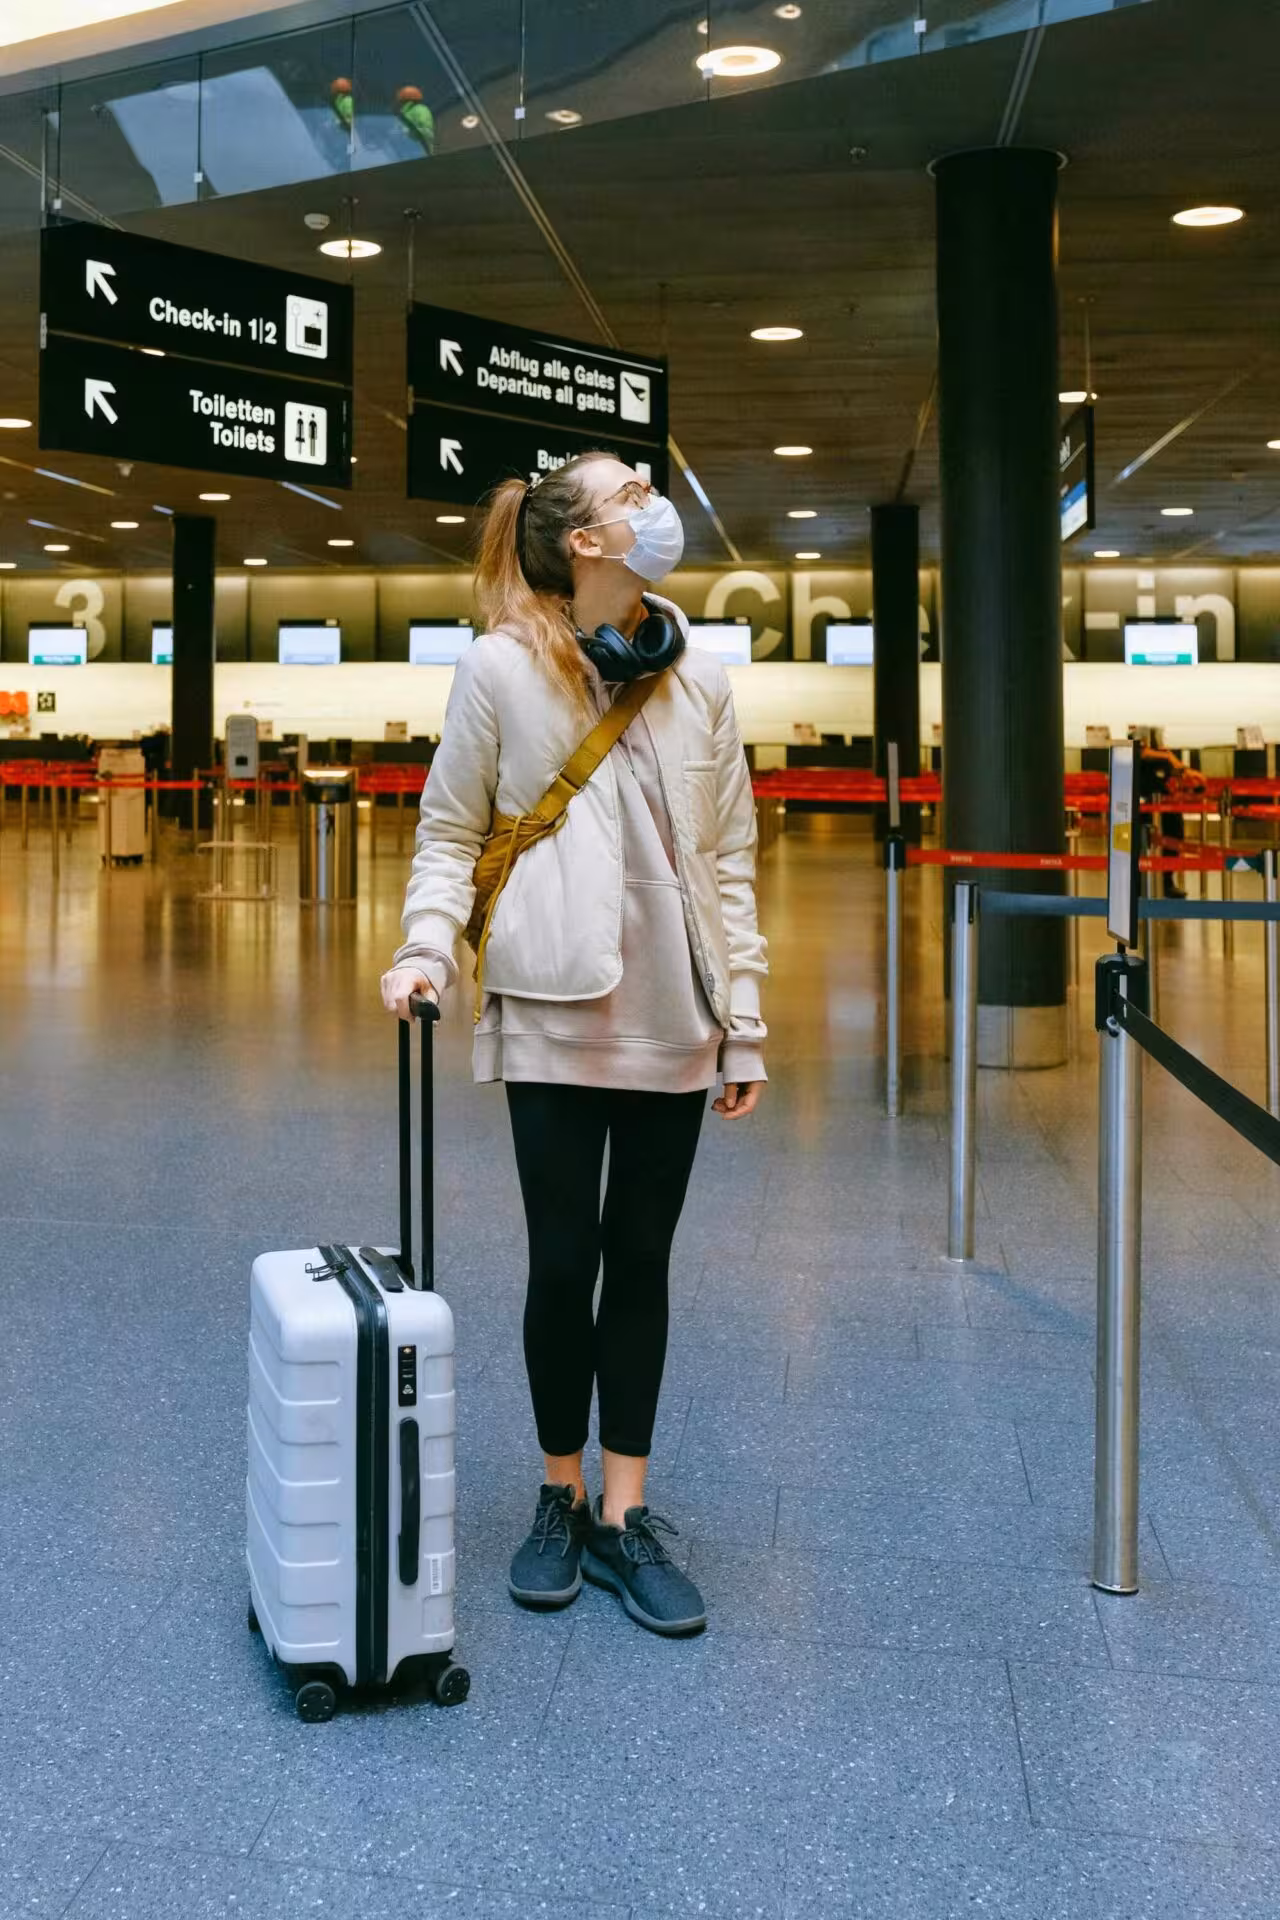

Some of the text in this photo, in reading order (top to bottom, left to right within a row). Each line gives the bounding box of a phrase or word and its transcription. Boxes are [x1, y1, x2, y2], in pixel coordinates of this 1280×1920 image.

[149, 297, 241, 337] Check-in
[489, 346, 615, 391] Abflug alle Gates
[189, 389, 275, 425] Toiletten
[477, 367, 615, 414] Departure all gates
[210, 421, 275, 453] Toilets
[54, 579, 106, 661] 3
